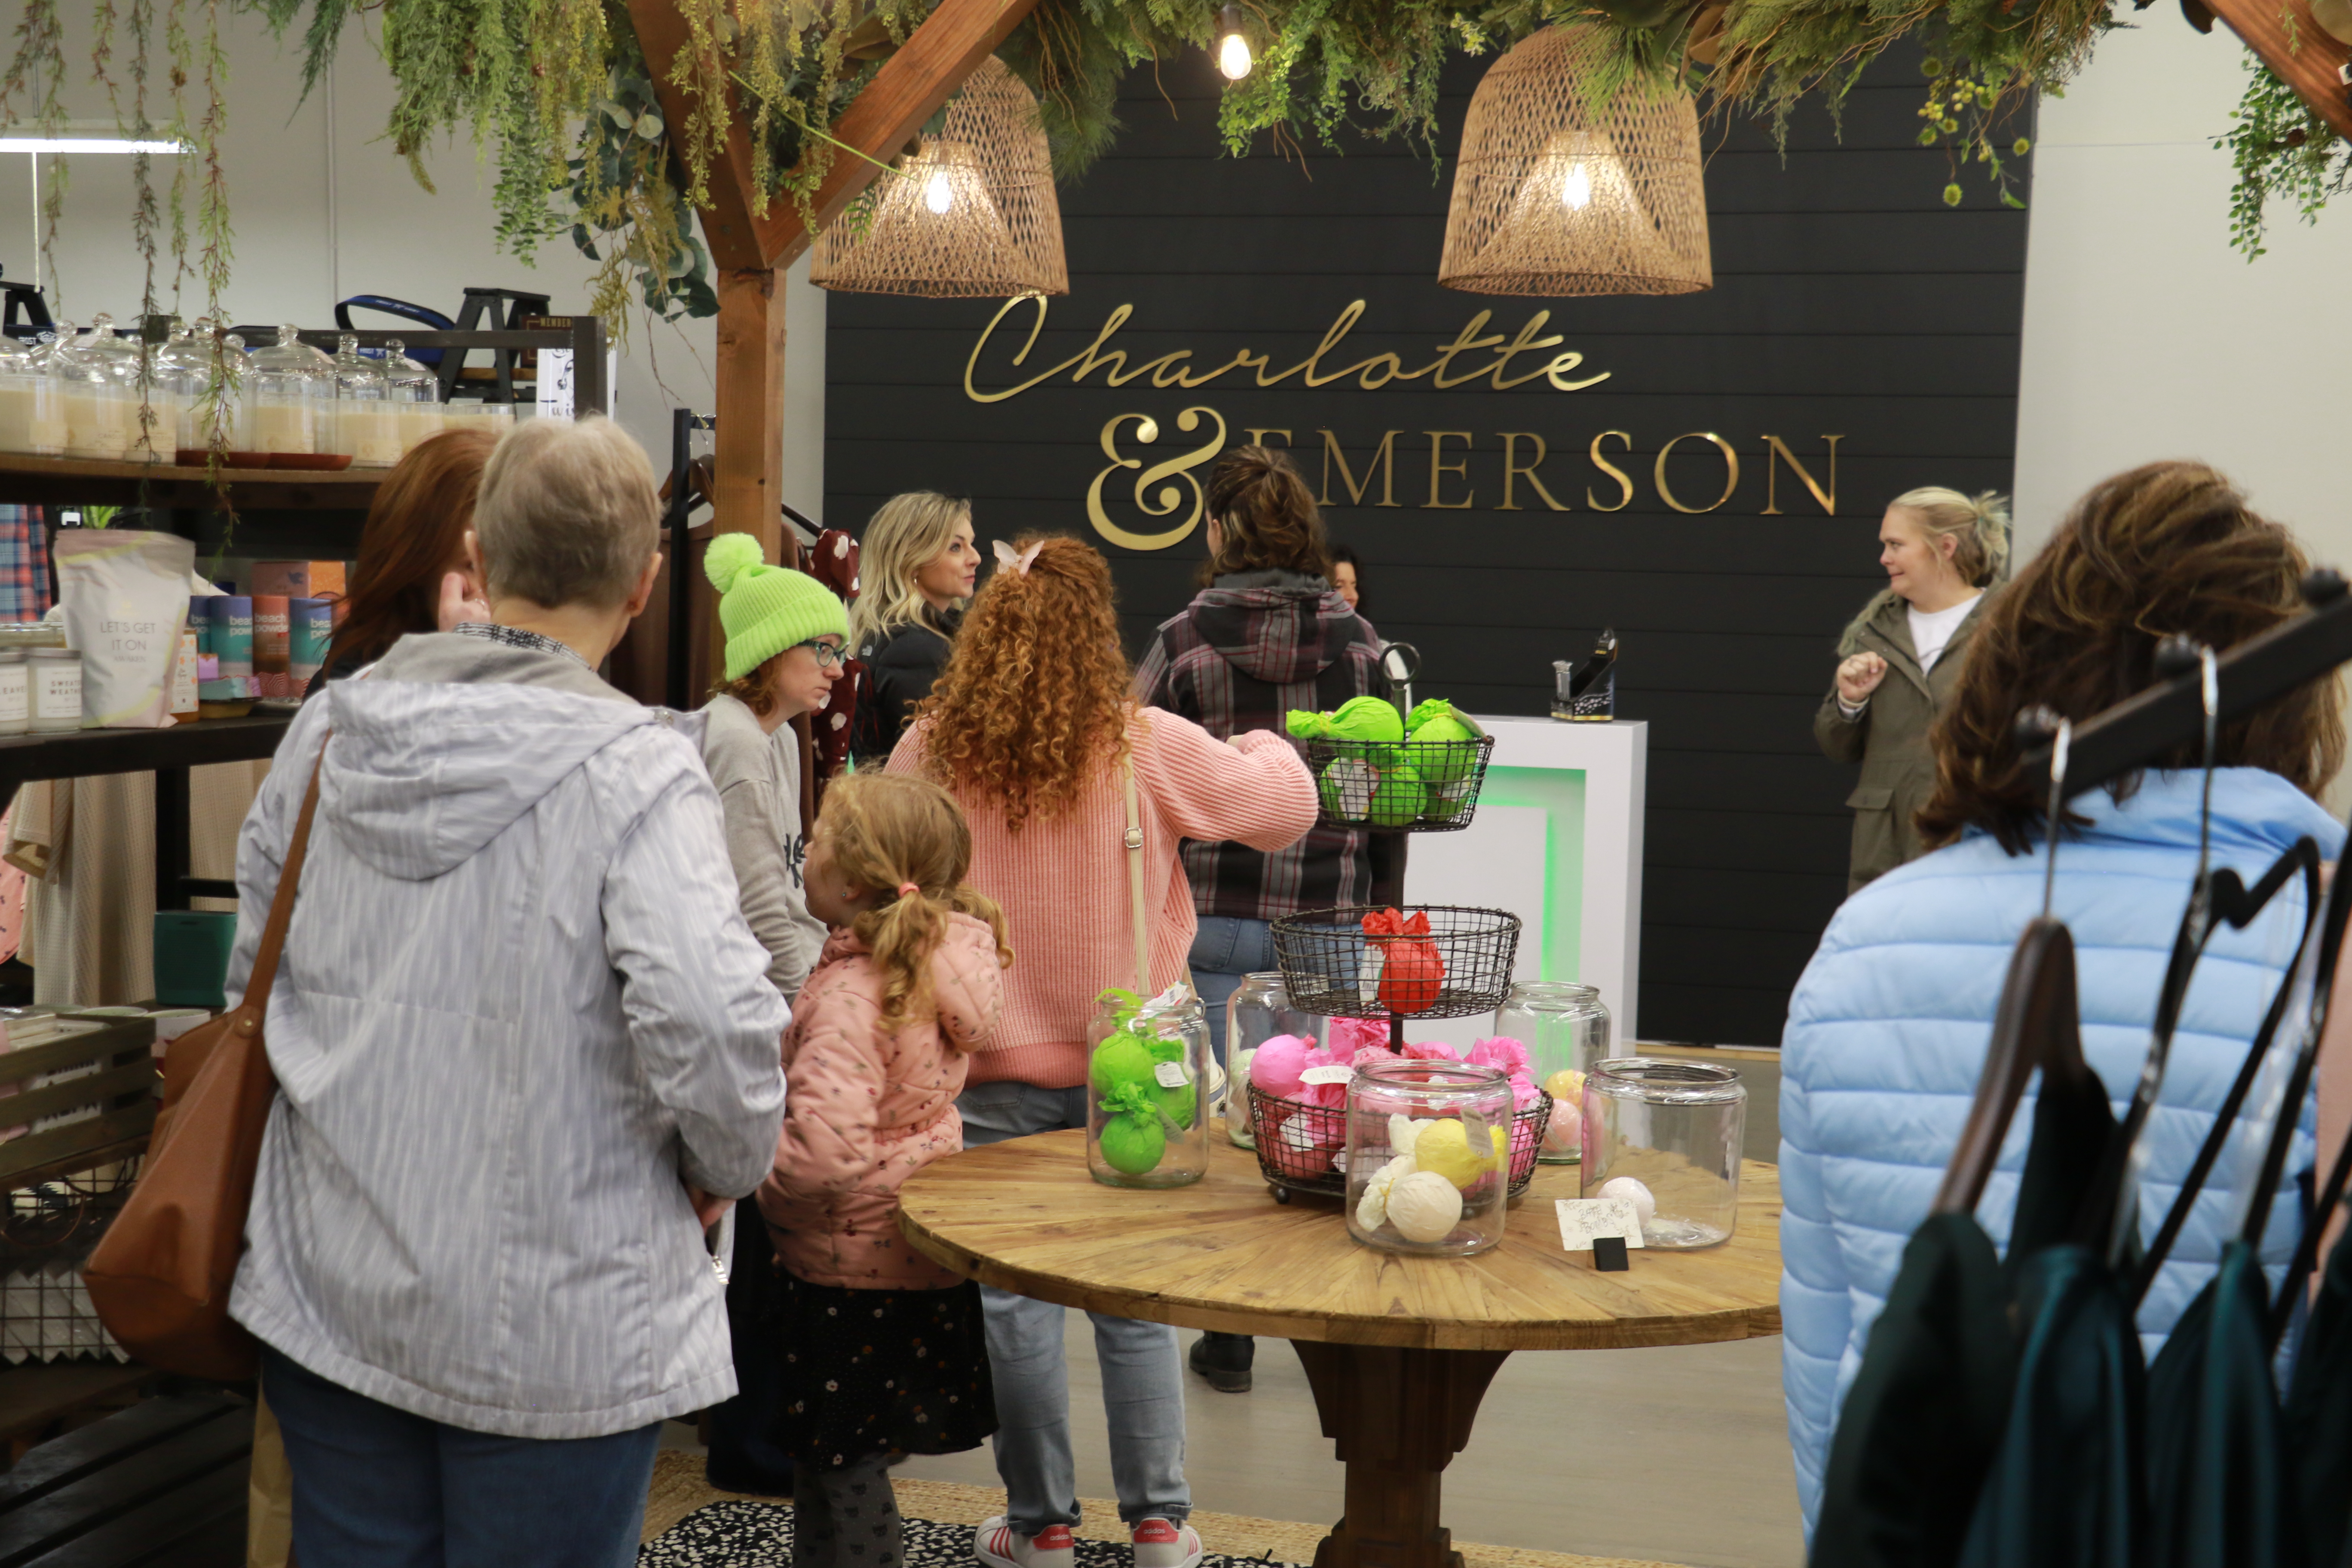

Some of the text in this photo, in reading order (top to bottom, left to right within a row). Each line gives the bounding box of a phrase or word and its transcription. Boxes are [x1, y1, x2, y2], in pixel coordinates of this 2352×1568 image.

[965, 290, 1611, 403] Charlotte
[1087, 406, 1226, 551] &
[254, 613, 286, 623] beach
[101, 622, 155, 634] LET'S GET
[112, 640, 147, 650] IT ON
